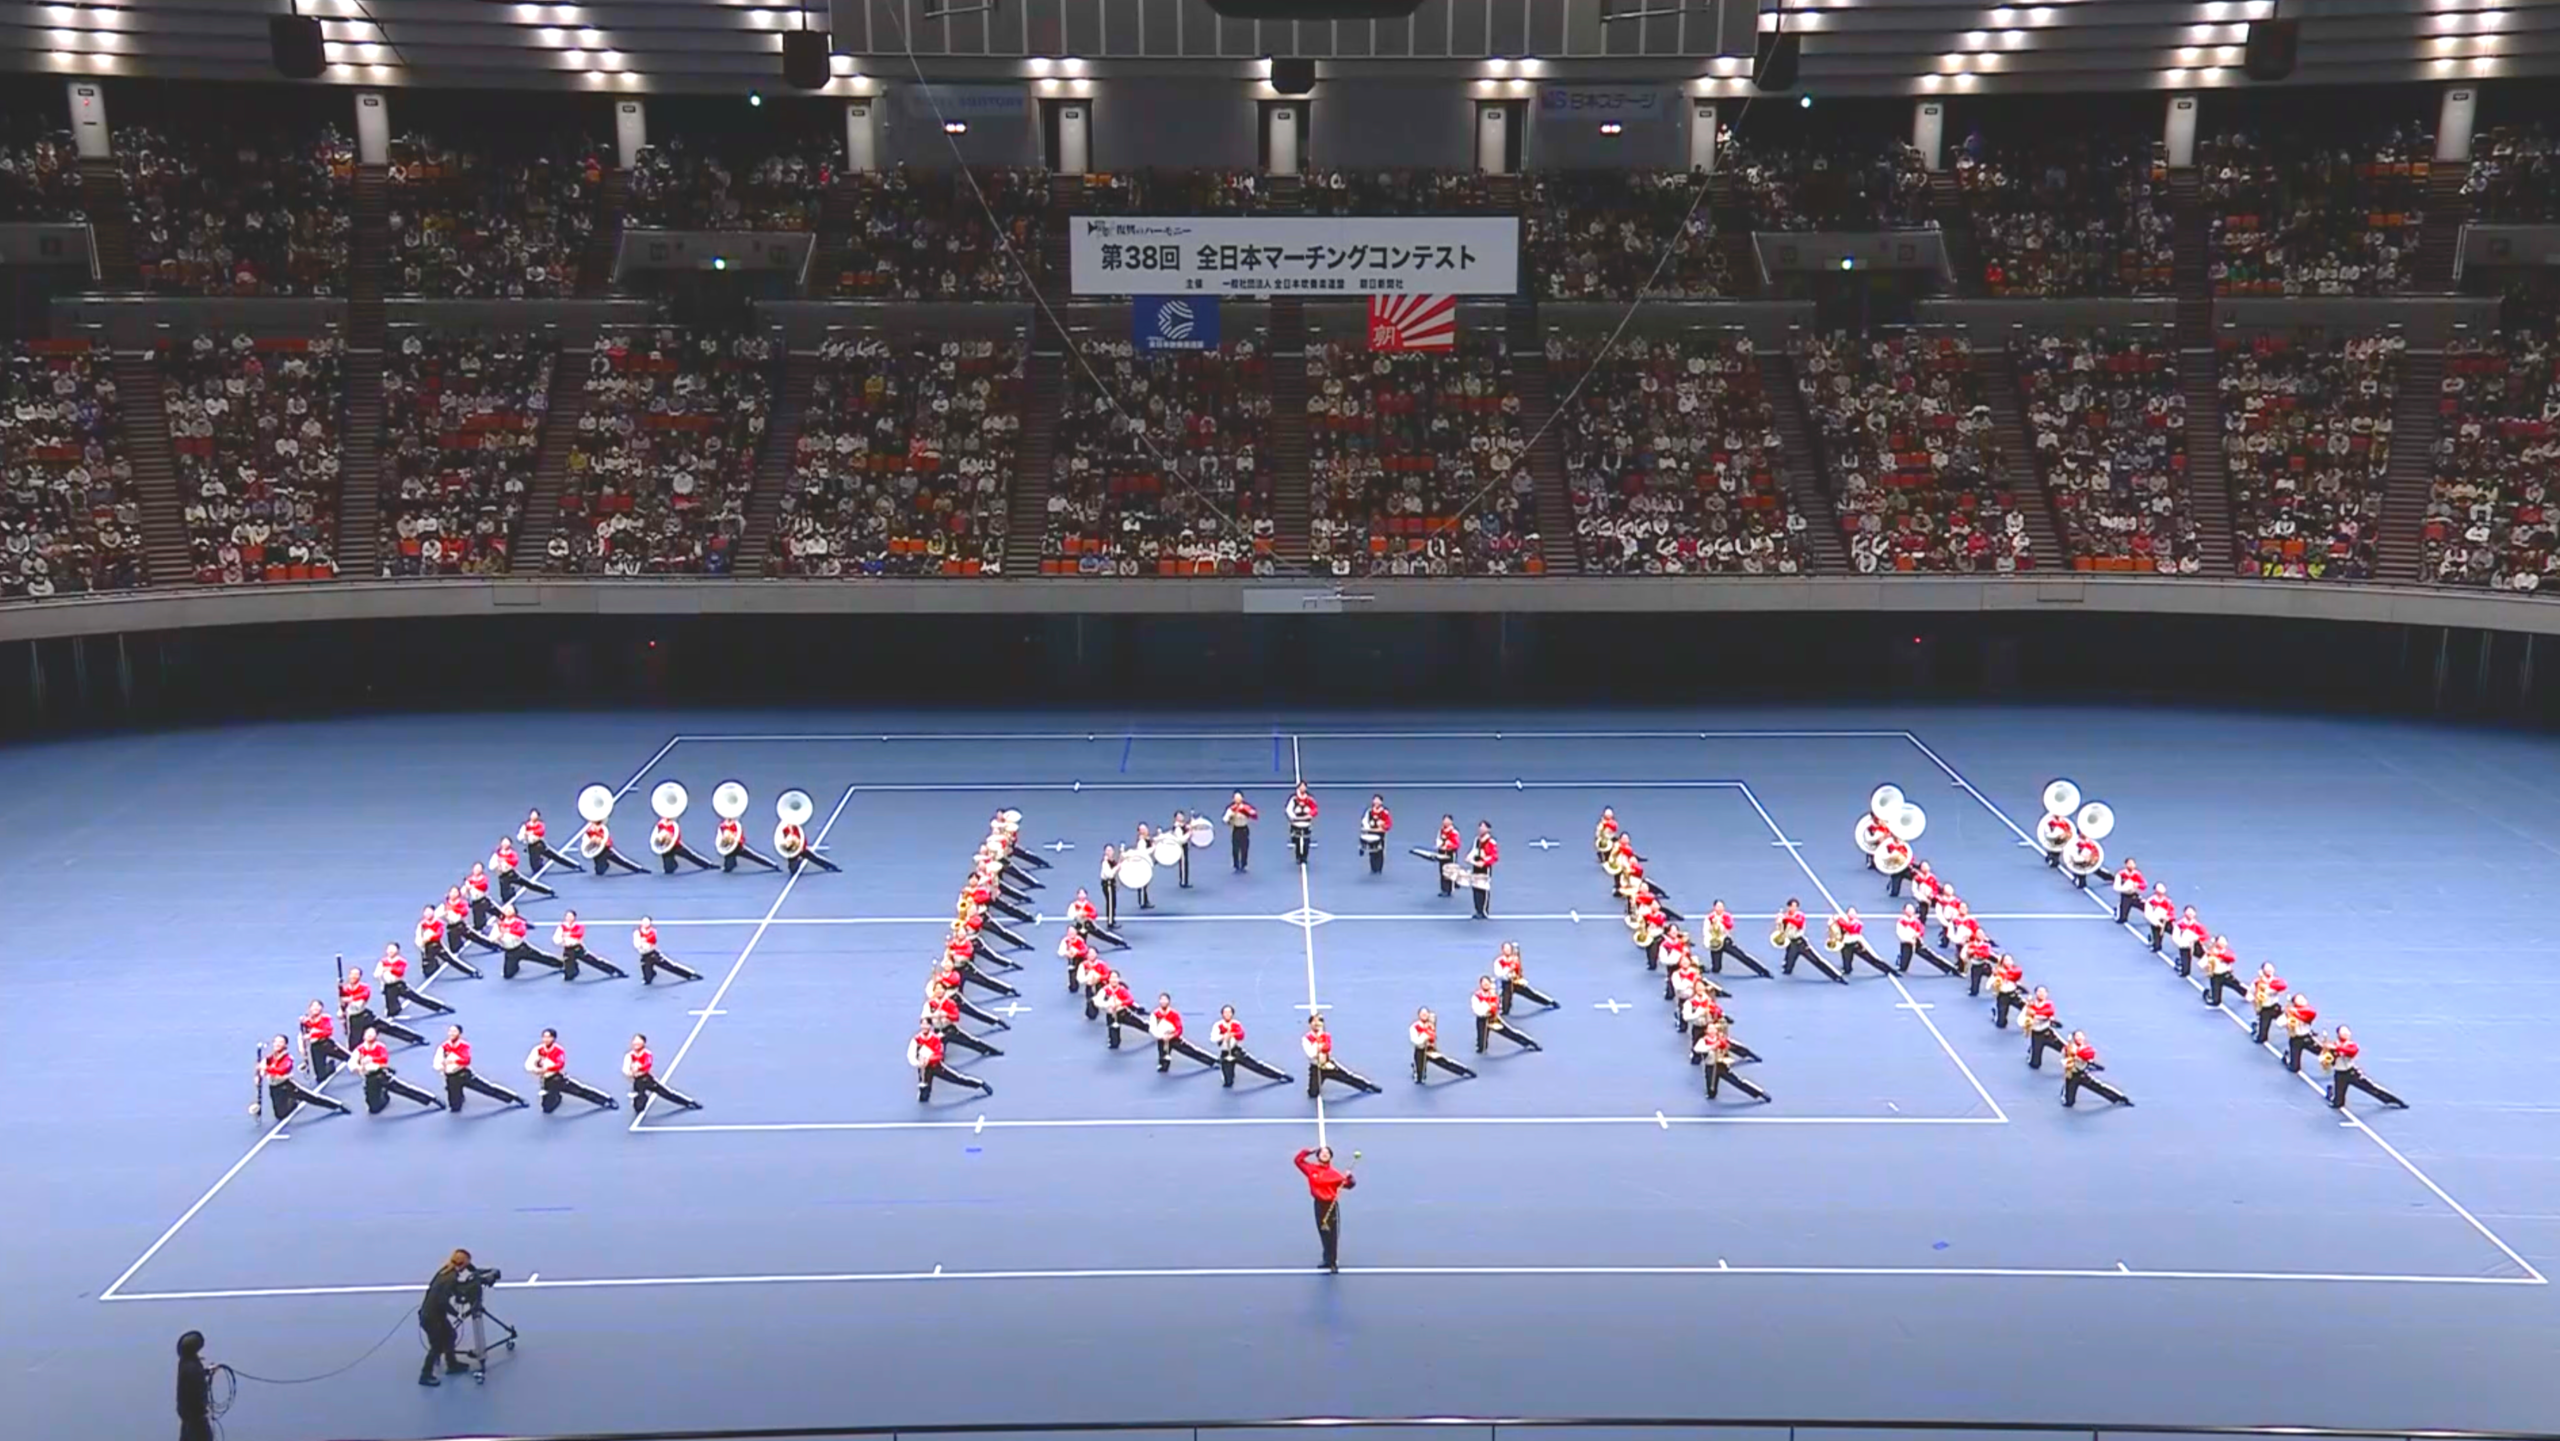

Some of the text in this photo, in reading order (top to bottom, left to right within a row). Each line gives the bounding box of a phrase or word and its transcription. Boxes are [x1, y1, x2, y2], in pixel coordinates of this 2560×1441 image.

[1101, 244, 1476, 271] 第38回 全日本マーチングコンテスト
